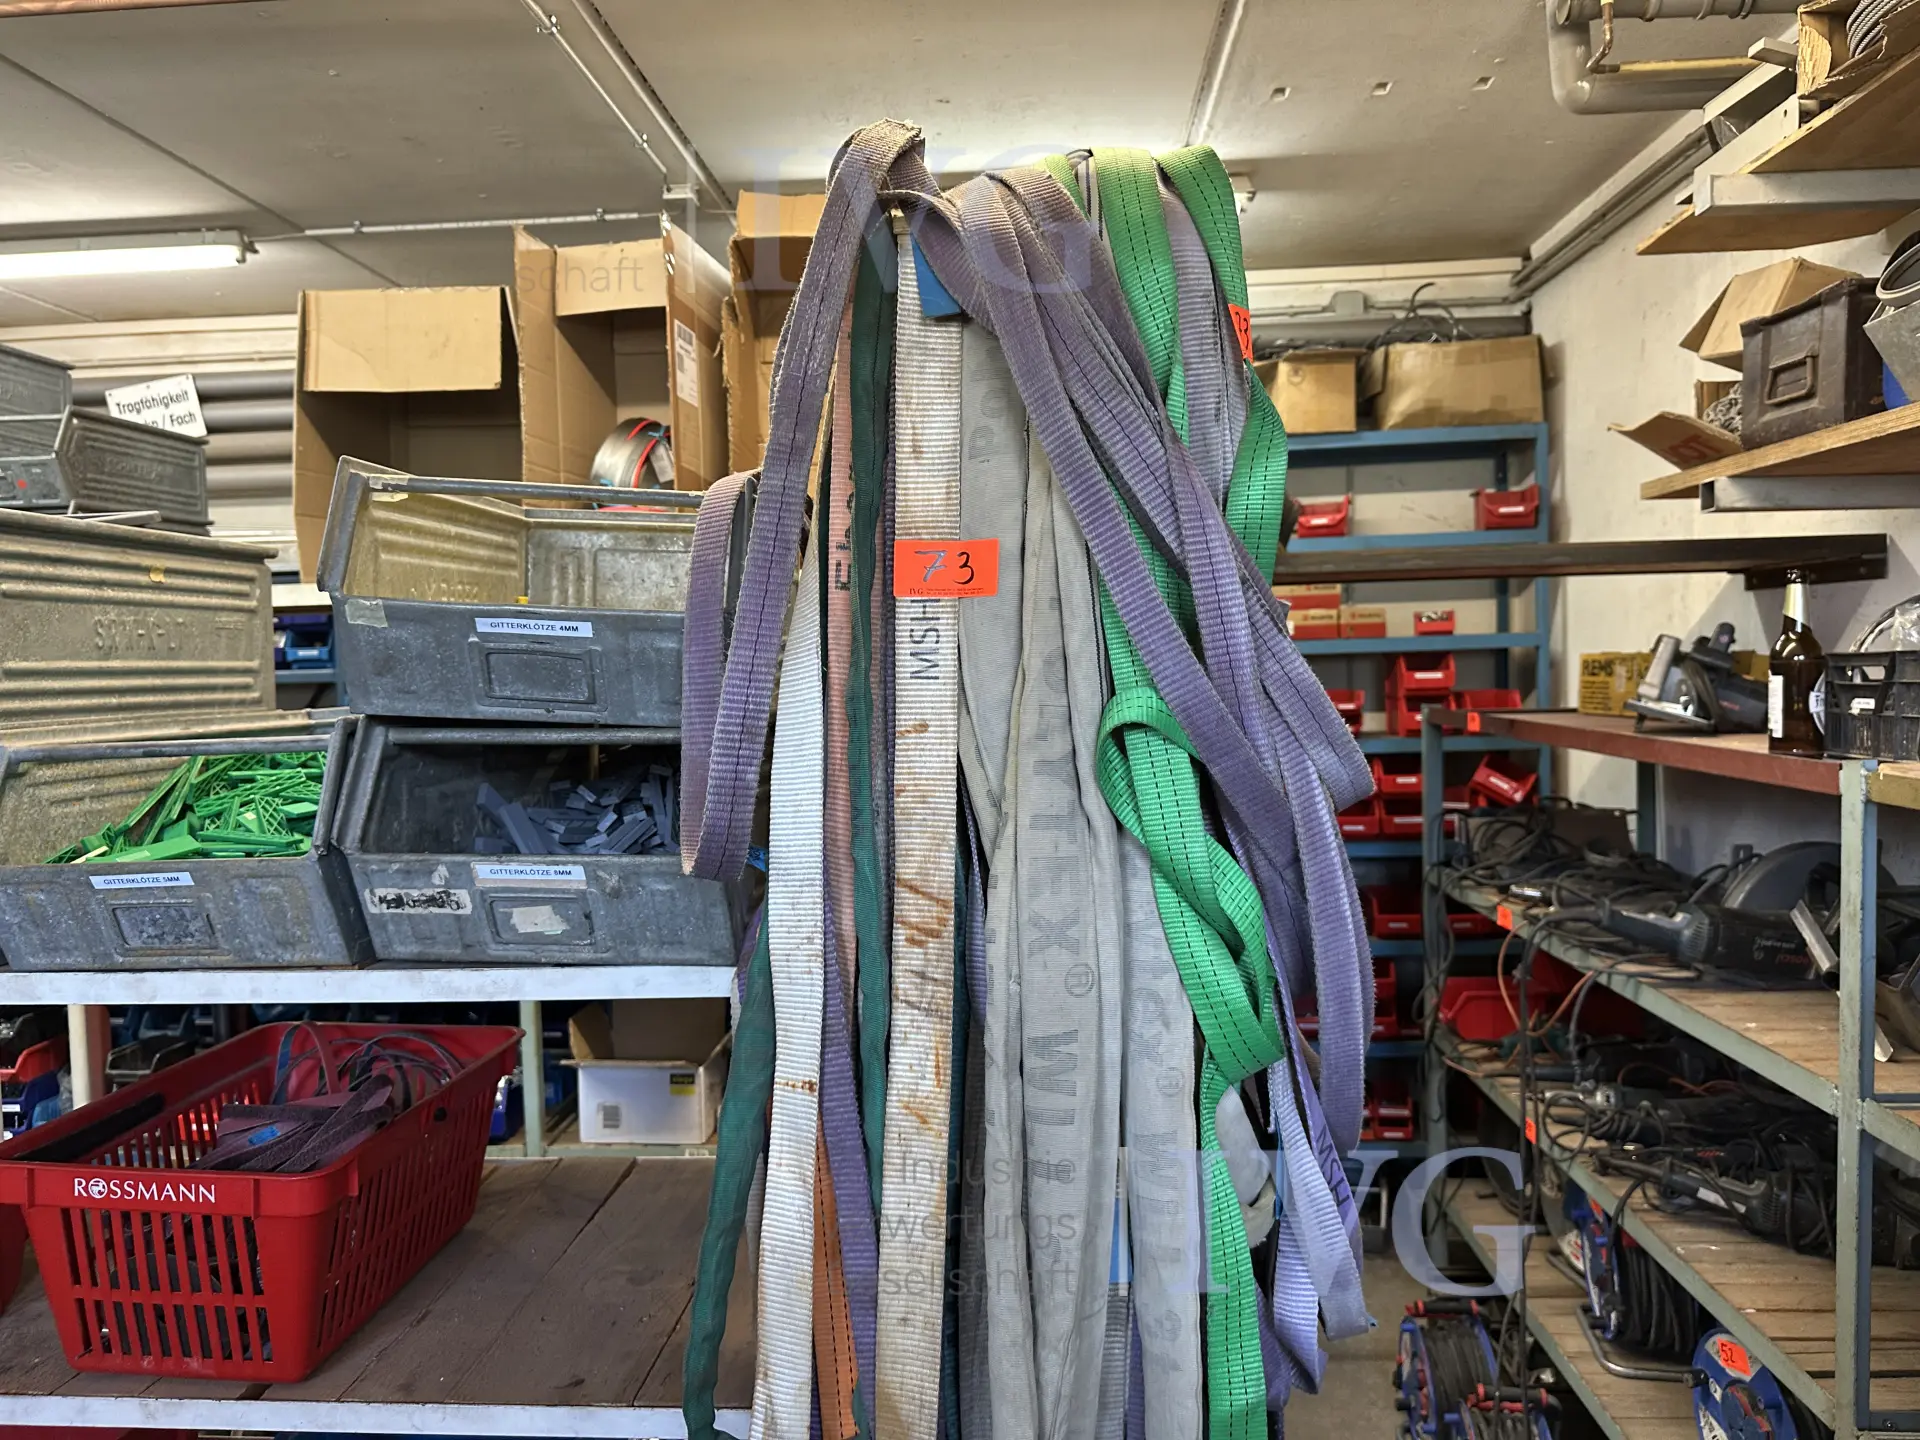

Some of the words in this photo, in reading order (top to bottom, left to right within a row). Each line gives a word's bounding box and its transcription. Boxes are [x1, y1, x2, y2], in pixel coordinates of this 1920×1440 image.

[115, 390, 189, 416] Tragfähigkeit
[170, 411, 197, 427] Fach
[914, 550, 975, 585] 73
[489, 621, 557, 632] GITTERKLÖTZE
[559, 625, 579, 633] 4MM
[103, 876, 162, 886] GITTERKLÖTZE
[162, 875, 181, 883] 5MM
[489, 867, 552, 877] GITTERKLÖTZE
[74, 1177, 216, 1204] ROSSMANN
[1720, 1342, 1736, 1363] 52
